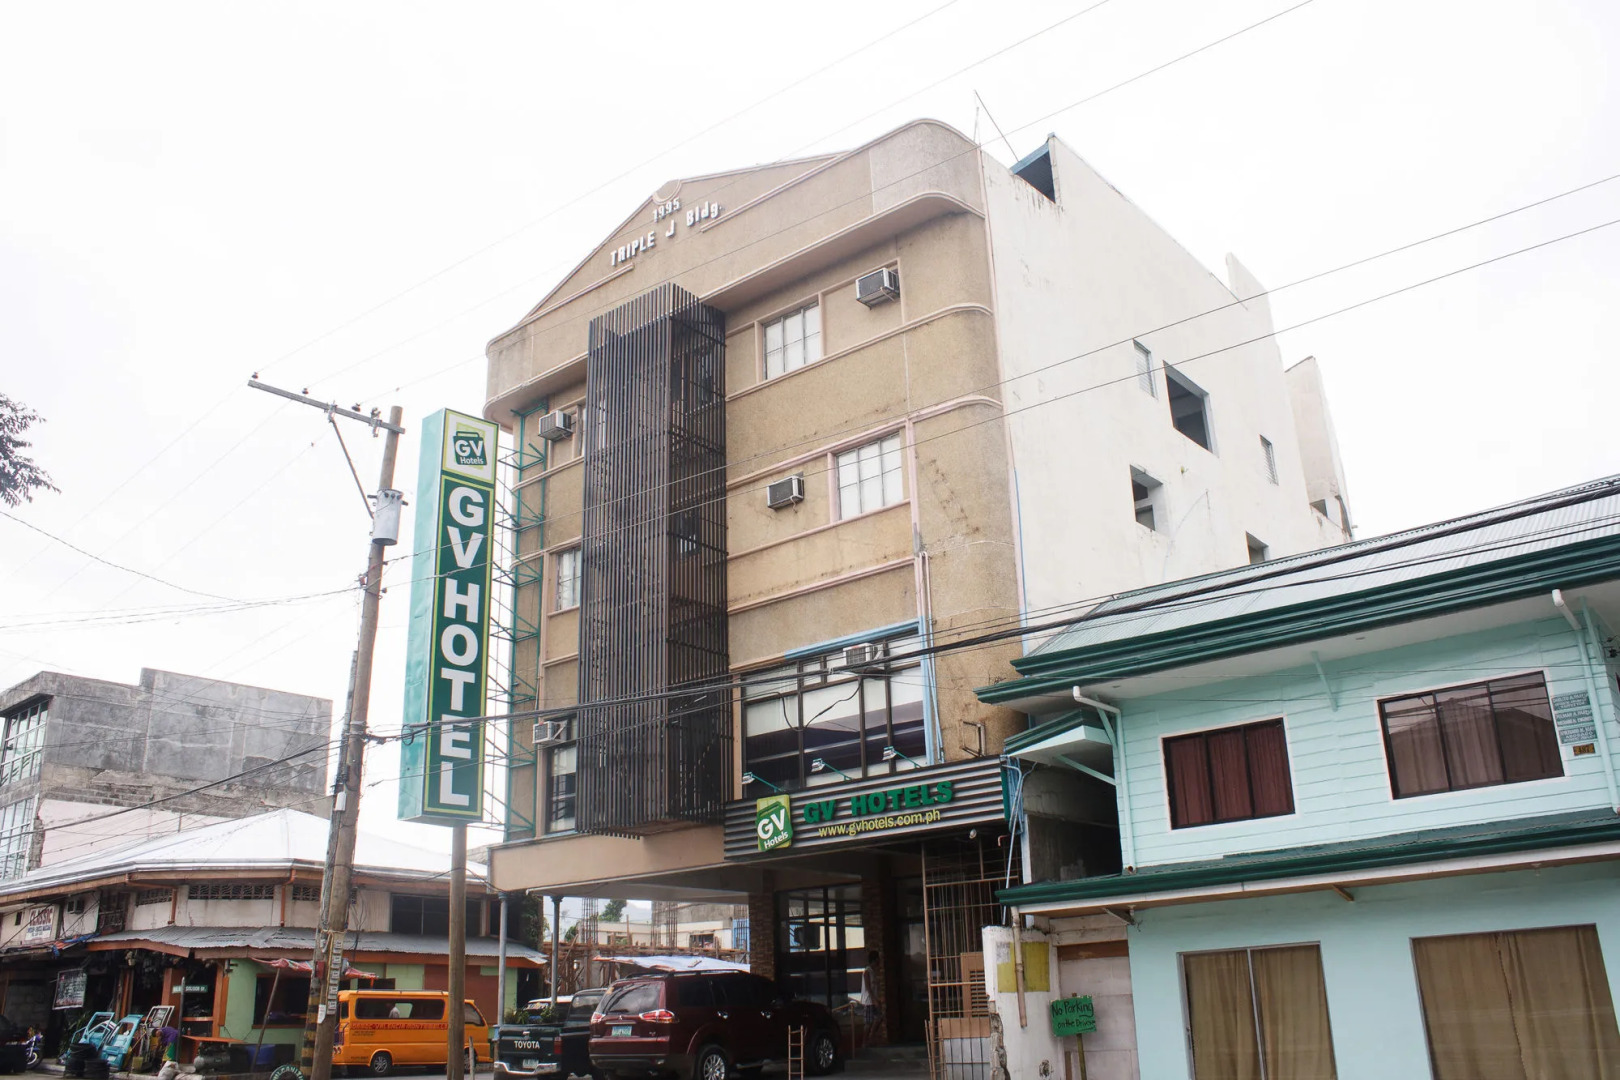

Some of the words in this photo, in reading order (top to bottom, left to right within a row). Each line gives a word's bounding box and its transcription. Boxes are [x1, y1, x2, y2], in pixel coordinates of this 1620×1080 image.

[653, 196, 681, 223] 1995
[610, 231, 656, 267] TRIPLE
[665, 219, 675, 237] J
[455, 439, 484, 457] GV
[460, 456, 484, 465] Hotels
[803, 800, 836, 824] GV
[850, 781, 953, 816] HOTELS
[757, 808, 786, 840] GV
[818, 808, 941, 838] www.gvhotels.com.ph
[764, 831, 789, 850] Hotels
[1051, 1002, 1063, 1018] No
[1063, 999, 1094, 1018] Parking
[513, 1040, 541, 1049] TOYOTA
